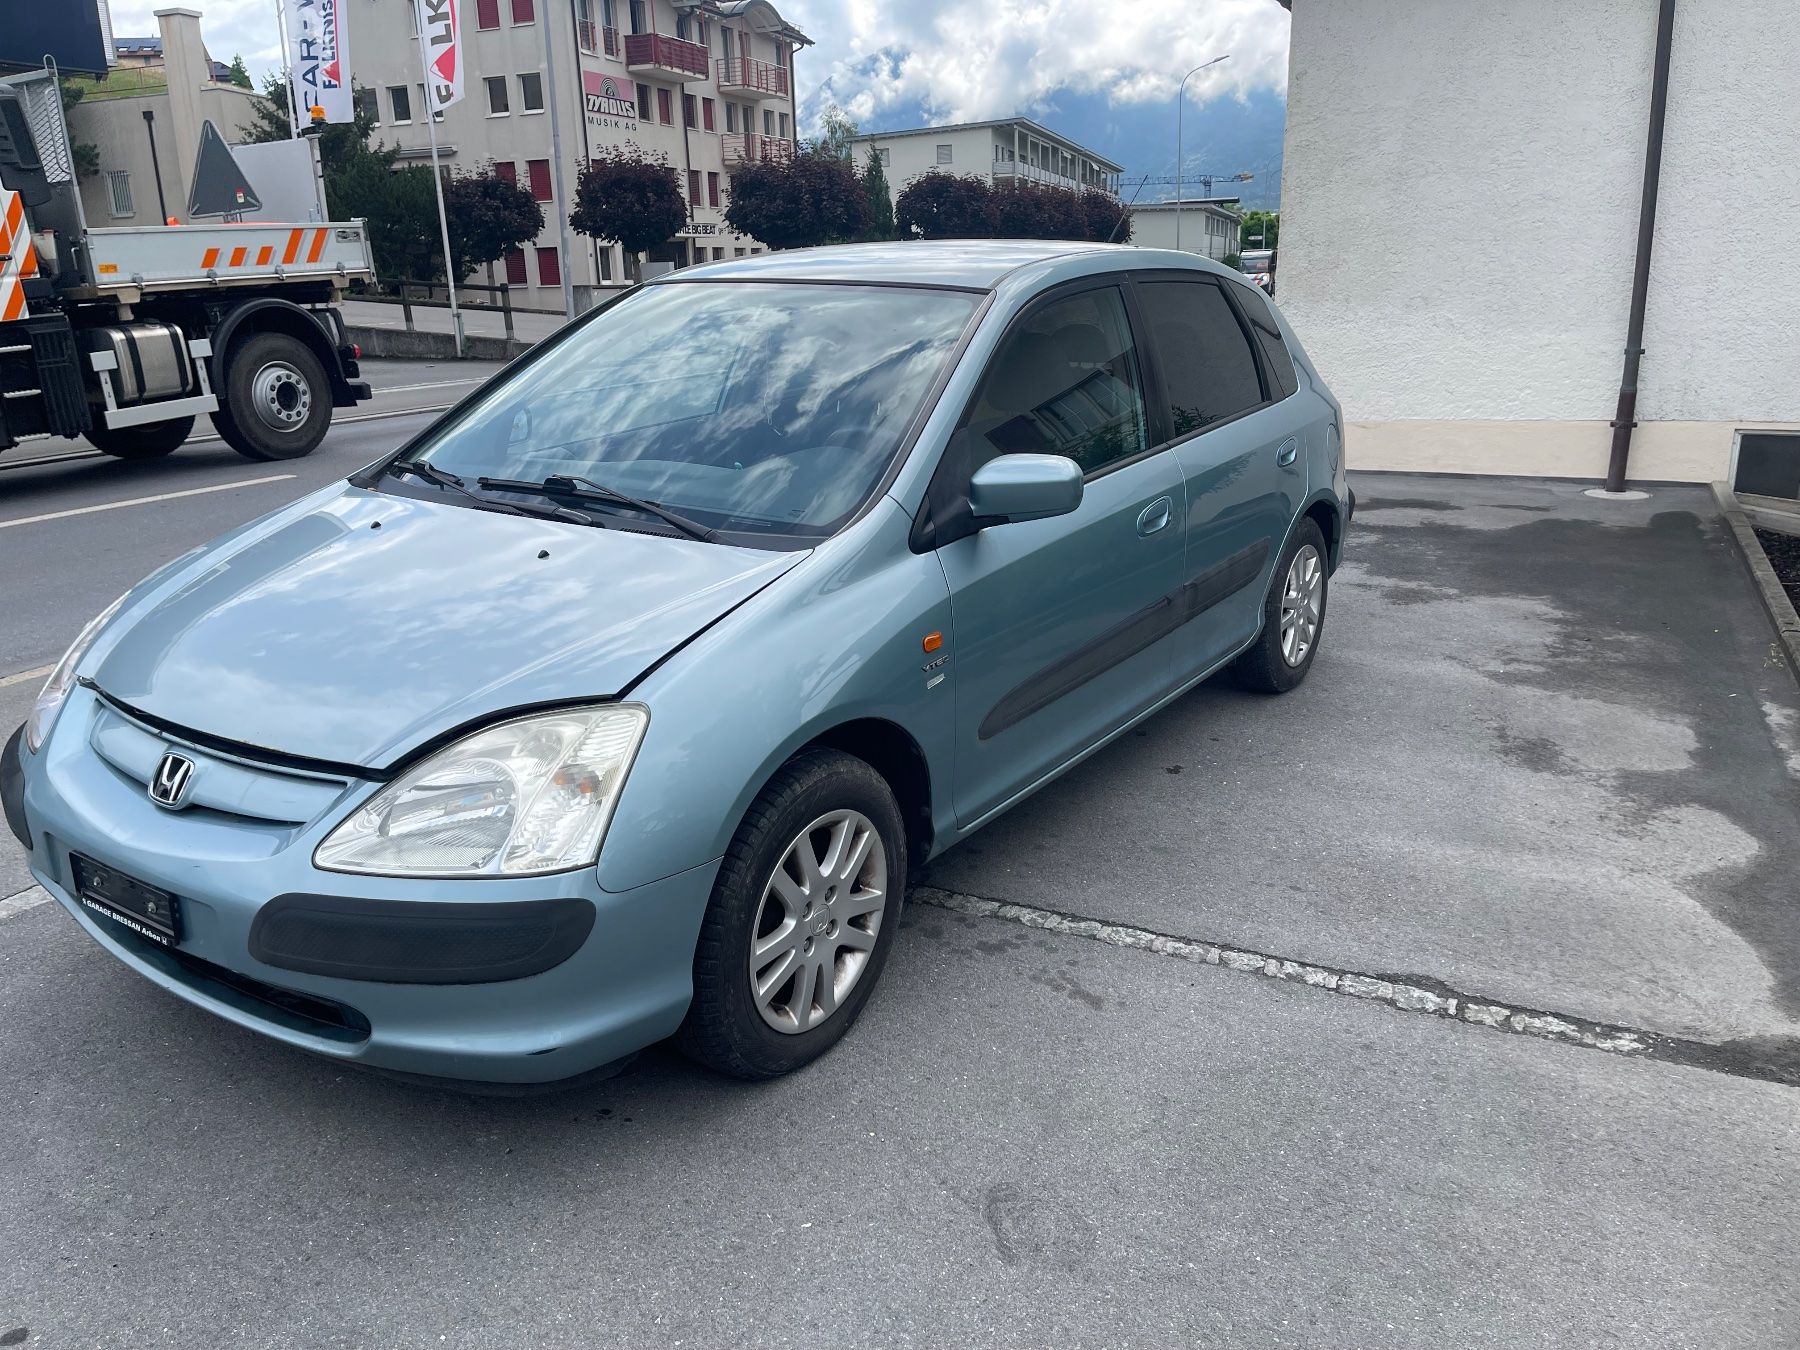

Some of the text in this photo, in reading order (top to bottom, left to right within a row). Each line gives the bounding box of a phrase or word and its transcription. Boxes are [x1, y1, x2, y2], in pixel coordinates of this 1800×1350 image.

[587, 94, 635, 118] TYROLIS
[587, 116, 637, 131] MUSIK AG
[692, 224, 701, 234] BIG
[702, 224, 716, 234] BEAT
[87, 900, 112, 918] GARAGE
[112, 912, 141, 932] BRESSAN
